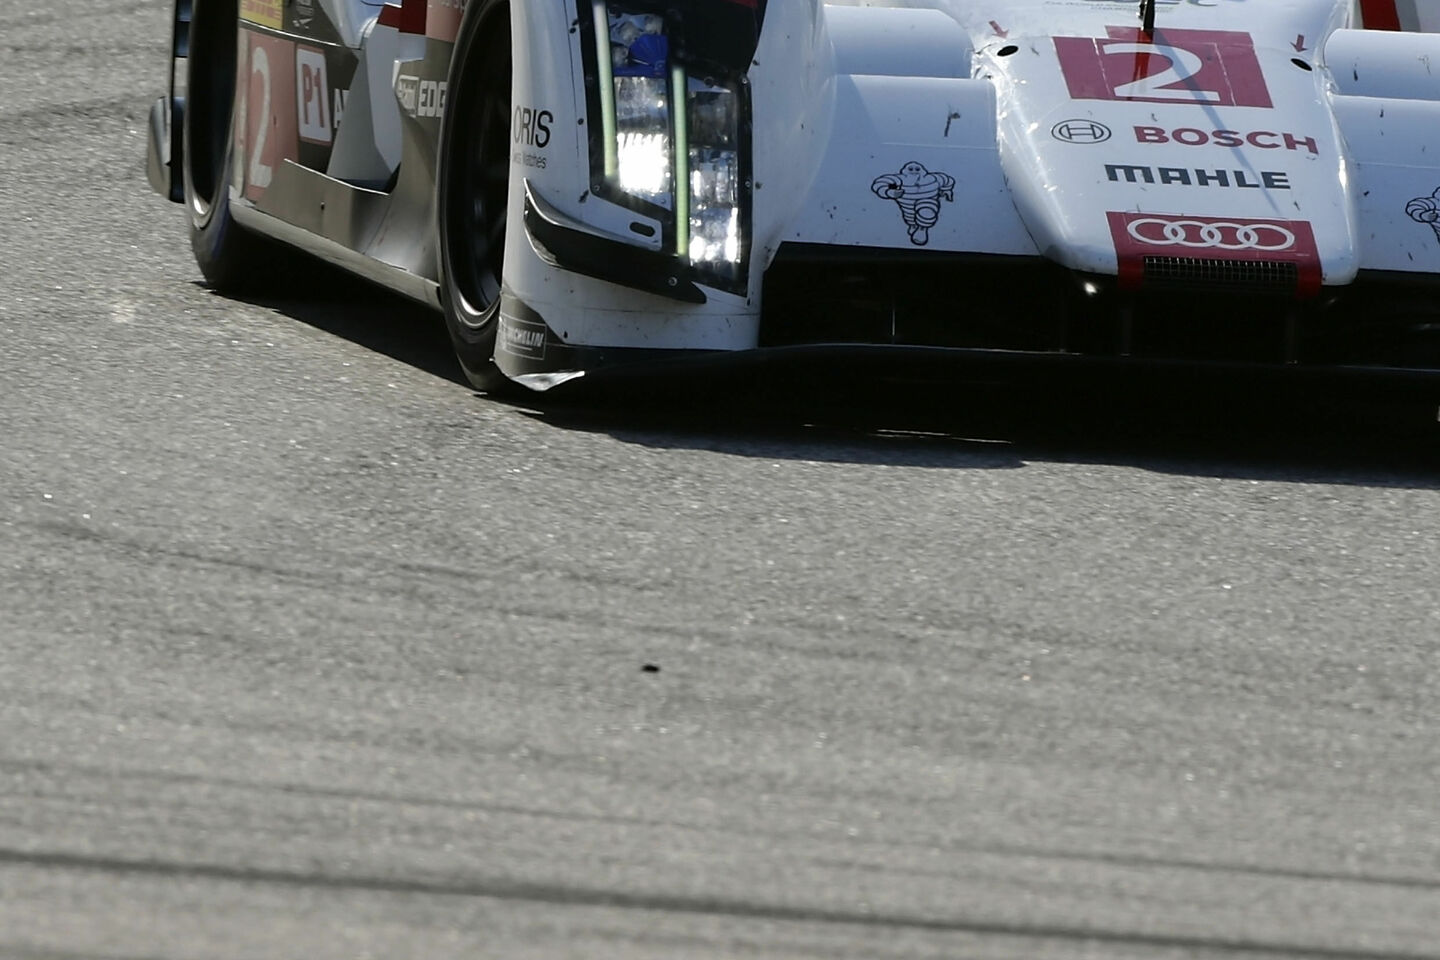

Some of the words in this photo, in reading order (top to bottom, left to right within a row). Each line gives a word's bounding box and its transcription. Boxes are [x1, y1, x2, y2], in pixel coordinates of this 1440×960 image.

[302, 63, 325, 129] P1
[1102, 42, 1221, 102] 2
[251, 46, 274, 188] 2
[513, 104, 554, 149] ORIS
[1133, 126, 1320, 155] BOSCH
[1104, 164, 1291, 190] MAHLE
